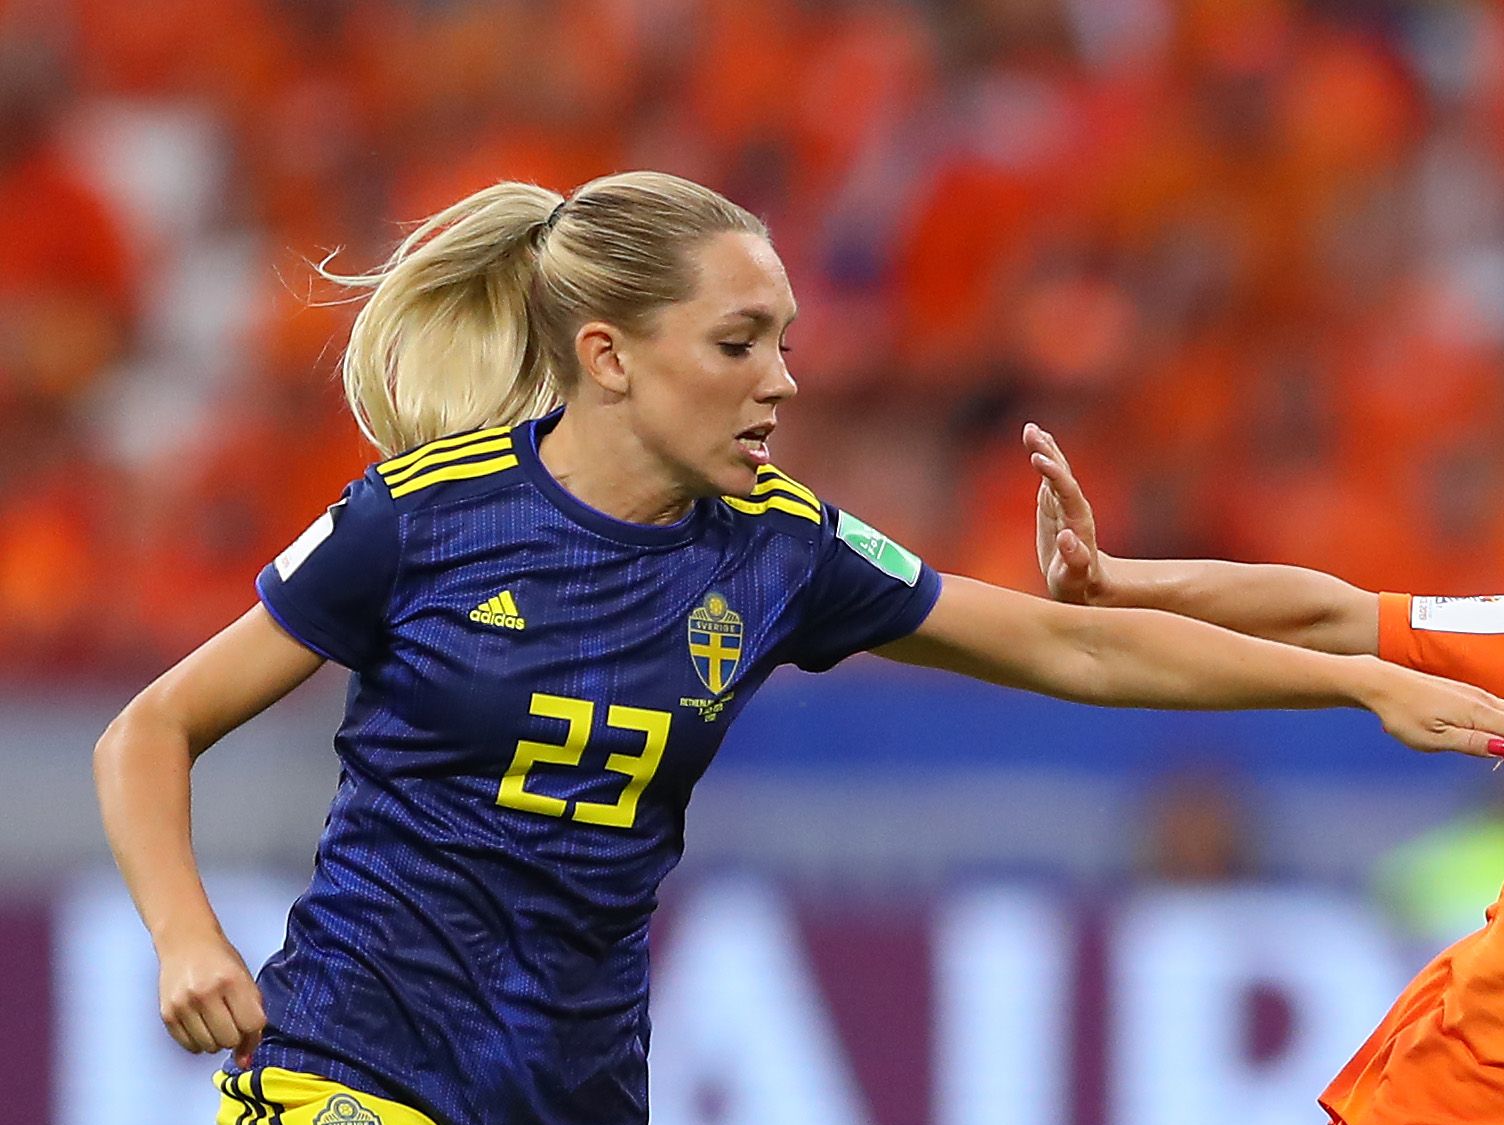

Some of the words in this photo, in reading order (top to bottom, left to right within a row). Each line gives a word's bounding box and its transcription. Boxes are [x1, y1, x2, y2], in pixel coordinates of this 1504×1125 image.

[469, 609, 525, 630] adidas
[696, 621, 736, 633] SVERIGE
[496, 693, 672, 828] 23
